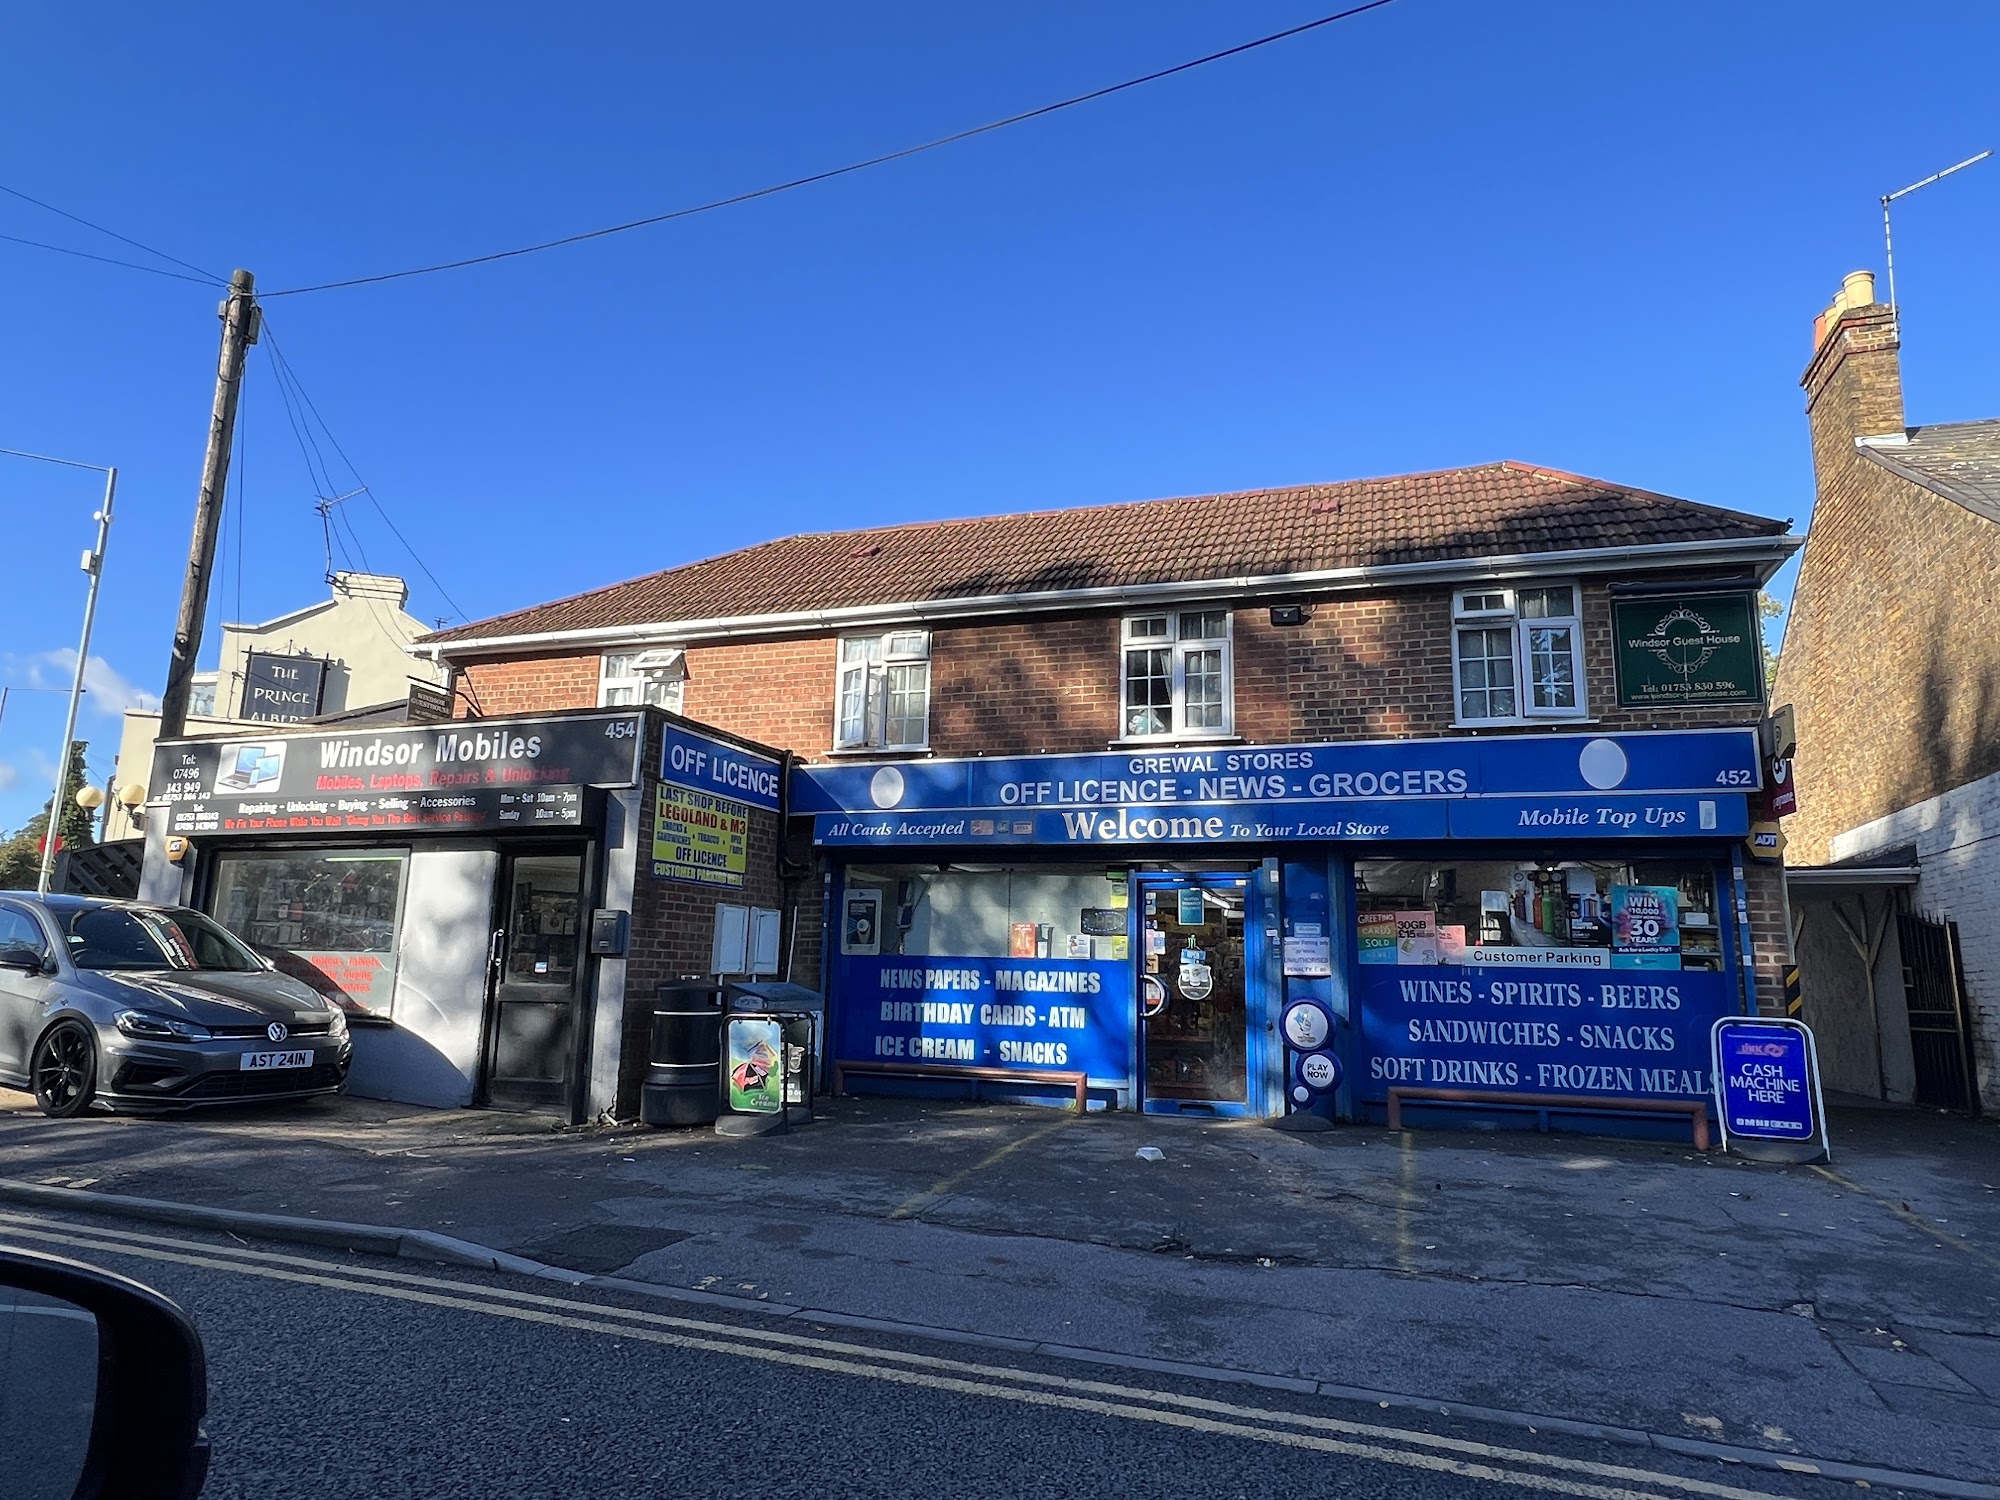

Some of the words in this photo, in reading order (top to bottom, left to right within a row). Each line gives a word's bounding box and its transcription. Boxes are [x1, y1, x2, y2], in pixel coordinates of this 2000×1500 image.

[1629, 638, 1671, 648] Windsor
[1673, 636, 1704, 646] Guest
[1706, 634, 1741, 645] House
[272, 666, 299, 680] THE
[254, 687, 310, 706] PRINCE
[604, 722, 636, 739] 454
[320, 739, 424, 768] Windsor
[435, 731, 541, 762] Mobiles
[671, 745, 707, 776] OFF
[712, 757, 779, 798] LICENCE
[1128, 755, 1219, 775] GREWAL
[1226, 751, 1314, 771] STORES
[172, 768, 200, 780] 07496
[316, 775, 365, 790] Mobiles,
[370, 774, 424, 790] Laptops,
[430, 769, 479, 786] Repairs
[485, 768, 496, 784] &
[501, 767, 570, 783] Unlocking
[1716, 770, 1752, 785] 452
[165, 783, 182, 793] 143
[183, 782, 201, 793] 949
[1000, 782, 1052, 803] OFF
[1058, 778, 1177, 803] LICENCE
[1199, 775, 1286, 799] NEWS
[1308, 768, 1468, 797] GROCERS
[238, 802, 278, 815] Repairing
[286, 800, 328, 814] Unlocking
[337, 799, 369, 813] Buying
[378, 798, 410, 811] Selling
[419, 795, 477, 808] Accessories
[660, 786, 686, 804] LAST
[687, 793, 714, 810] SHOP
[715, 800, 747, 819] BEFORE
[499, 810, 520, 821] Sunday
[659, 802, 717, 829] LEGOLAND
[720, 818, 728, 831] &
[730, 818, 746, 835] M3
[1062, 808, 1224, 840] Welcome
[1230, 823, 1251, 838] To
[1255, 823, 1293, 838] Your
[1296, 821, 1342, 837] Local
[1345, 821, 1390, 836] Store
[1518, 808, 1589, 826] Mobile
[1596, 807, 1637, 828] Top
[1644, 807, 1686, 828] Ups
[828, 822, 848, 837] All
[851, 823, 892, 837] Cards
[896, 820, 964, 840] Accepted
[1755, 834, 1777, 846] ADT
[675, 846, 692, 862] OFF
[693, 849, 727, 867] LICENCE
[654, 862, 696, 880] CUSTOMER
[1629, 896, 1659, 907] WIN
[1358, 914, 1394, 923] GREETING
[1398, 921, 1426, 930] 30GB
[1362, 926, 1391, 935] CARDS
[1398, 930, 1416, 938] £15
[1630, 919, 1659, 936] 30
[1365, 939, 1389, 947] SOLD
[1473, 950, 1543, 963] Customer
[1545, 951, 1601, 967] Parking
[995, 970, 1100, 993] MAGAZINES
[1399, 980, 1473, 1003] WINES
[1491, 982, 1582, 1006] SPIRITS
[1601, 985, 1681, 1010] BEERS
[881, 1001, 974, 1024] BIRTHDAY
[980, 1003, 1036, 1026] CARDS
[1048, 1007, 1085, 1028] ATM
[1408, 1019, 1560, 1046] SANDWICHES
[1580, 1024, 1675, 1051] SNACKS
[875, 1035, 904, 1055] ICE
[908, 1037, 975, 1060] CREAM
[1000, 1040, 1067, 1064] SNACKS
[250, 1053, 275, 1067] AST
[1307, 1063, 1328, 1071] PLAY
[1307, 1071, 1328, 1079] NOW
[1370, 1057, 1425, 1080] SOFT
[1432, 1060, 1518, 1085] DRINKS
[1538, 1064, 1634, 1091] FROZEN
[1742, 1063, 1783, 1077] CASH
[1730, 1076, 1800, 1092] MACHINE
[1748, 1089, 1785, 1104] HERE
